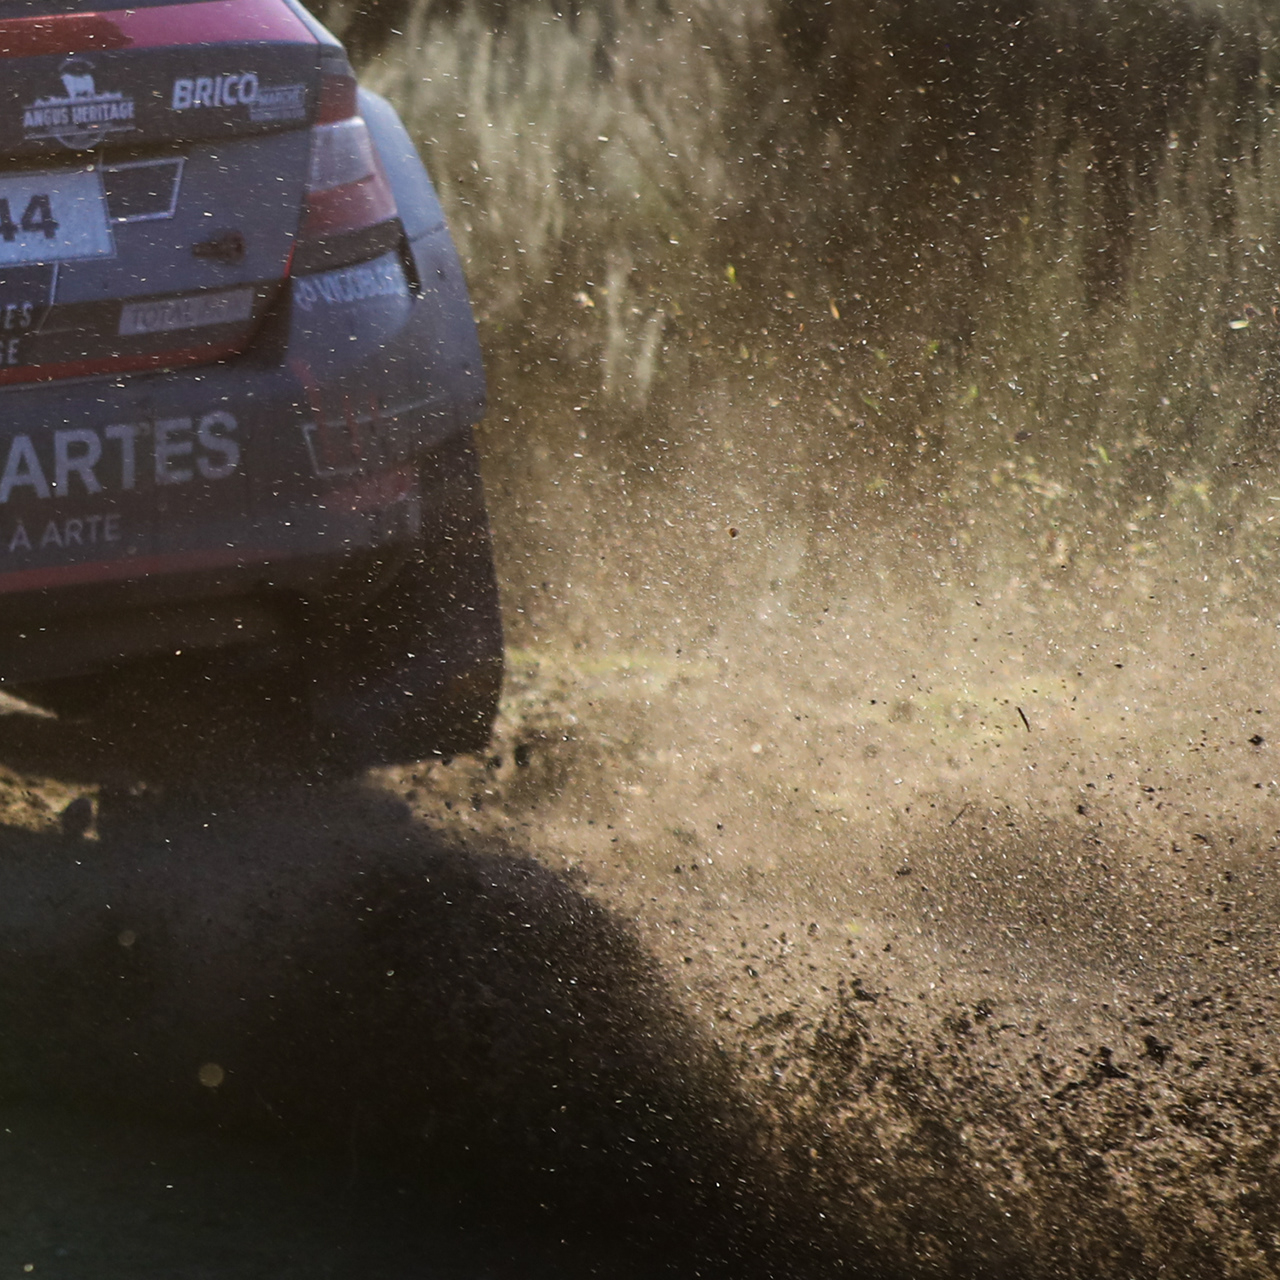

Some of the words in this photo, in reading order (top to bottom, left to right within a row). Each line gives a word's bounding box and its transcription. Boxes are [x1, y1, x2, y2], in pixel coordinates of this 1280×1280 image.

[172, 72, 259, 111] BRICO
[22, 107, 69, 128] ANGUS
[71, 99, 135, 124] HERITAGE
[41, 514, 122, 549] ARTE
